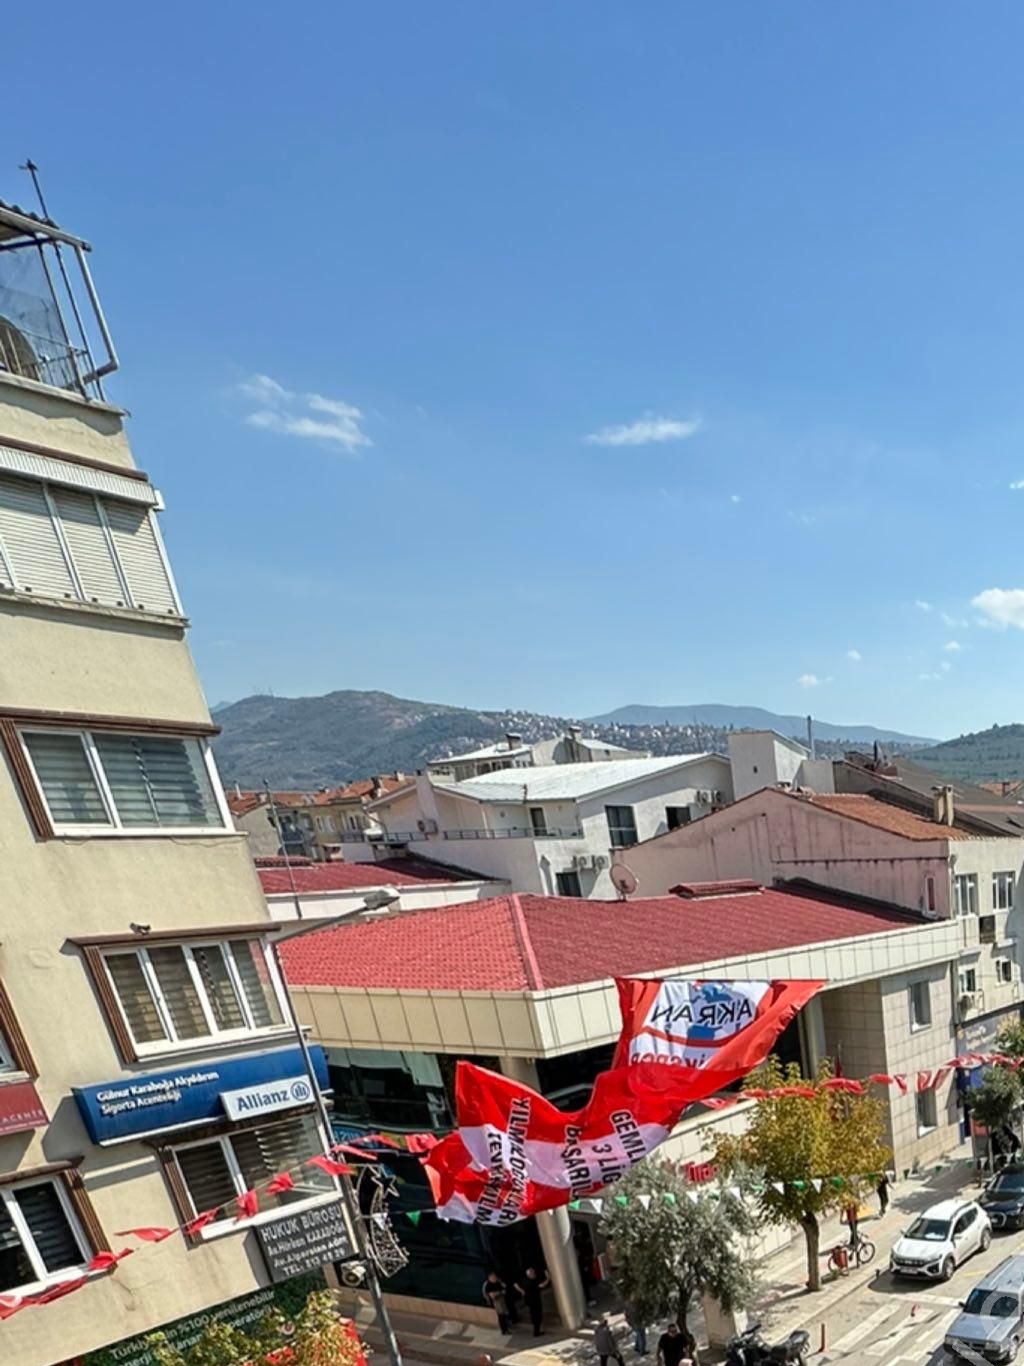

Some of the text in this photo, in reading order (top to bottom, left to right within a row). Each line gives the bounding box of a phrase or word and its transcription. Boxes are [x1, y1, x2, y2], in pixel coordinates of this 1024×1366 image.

[237, 1087, 291, 1113] Allianz
[592, 1143, 613, 1154] 3
[261, 1218, 301, 1243] HUKUK
[301, 1204, 342, 1230] BÜROSU
[178, 1314, 210, 1336] %100
